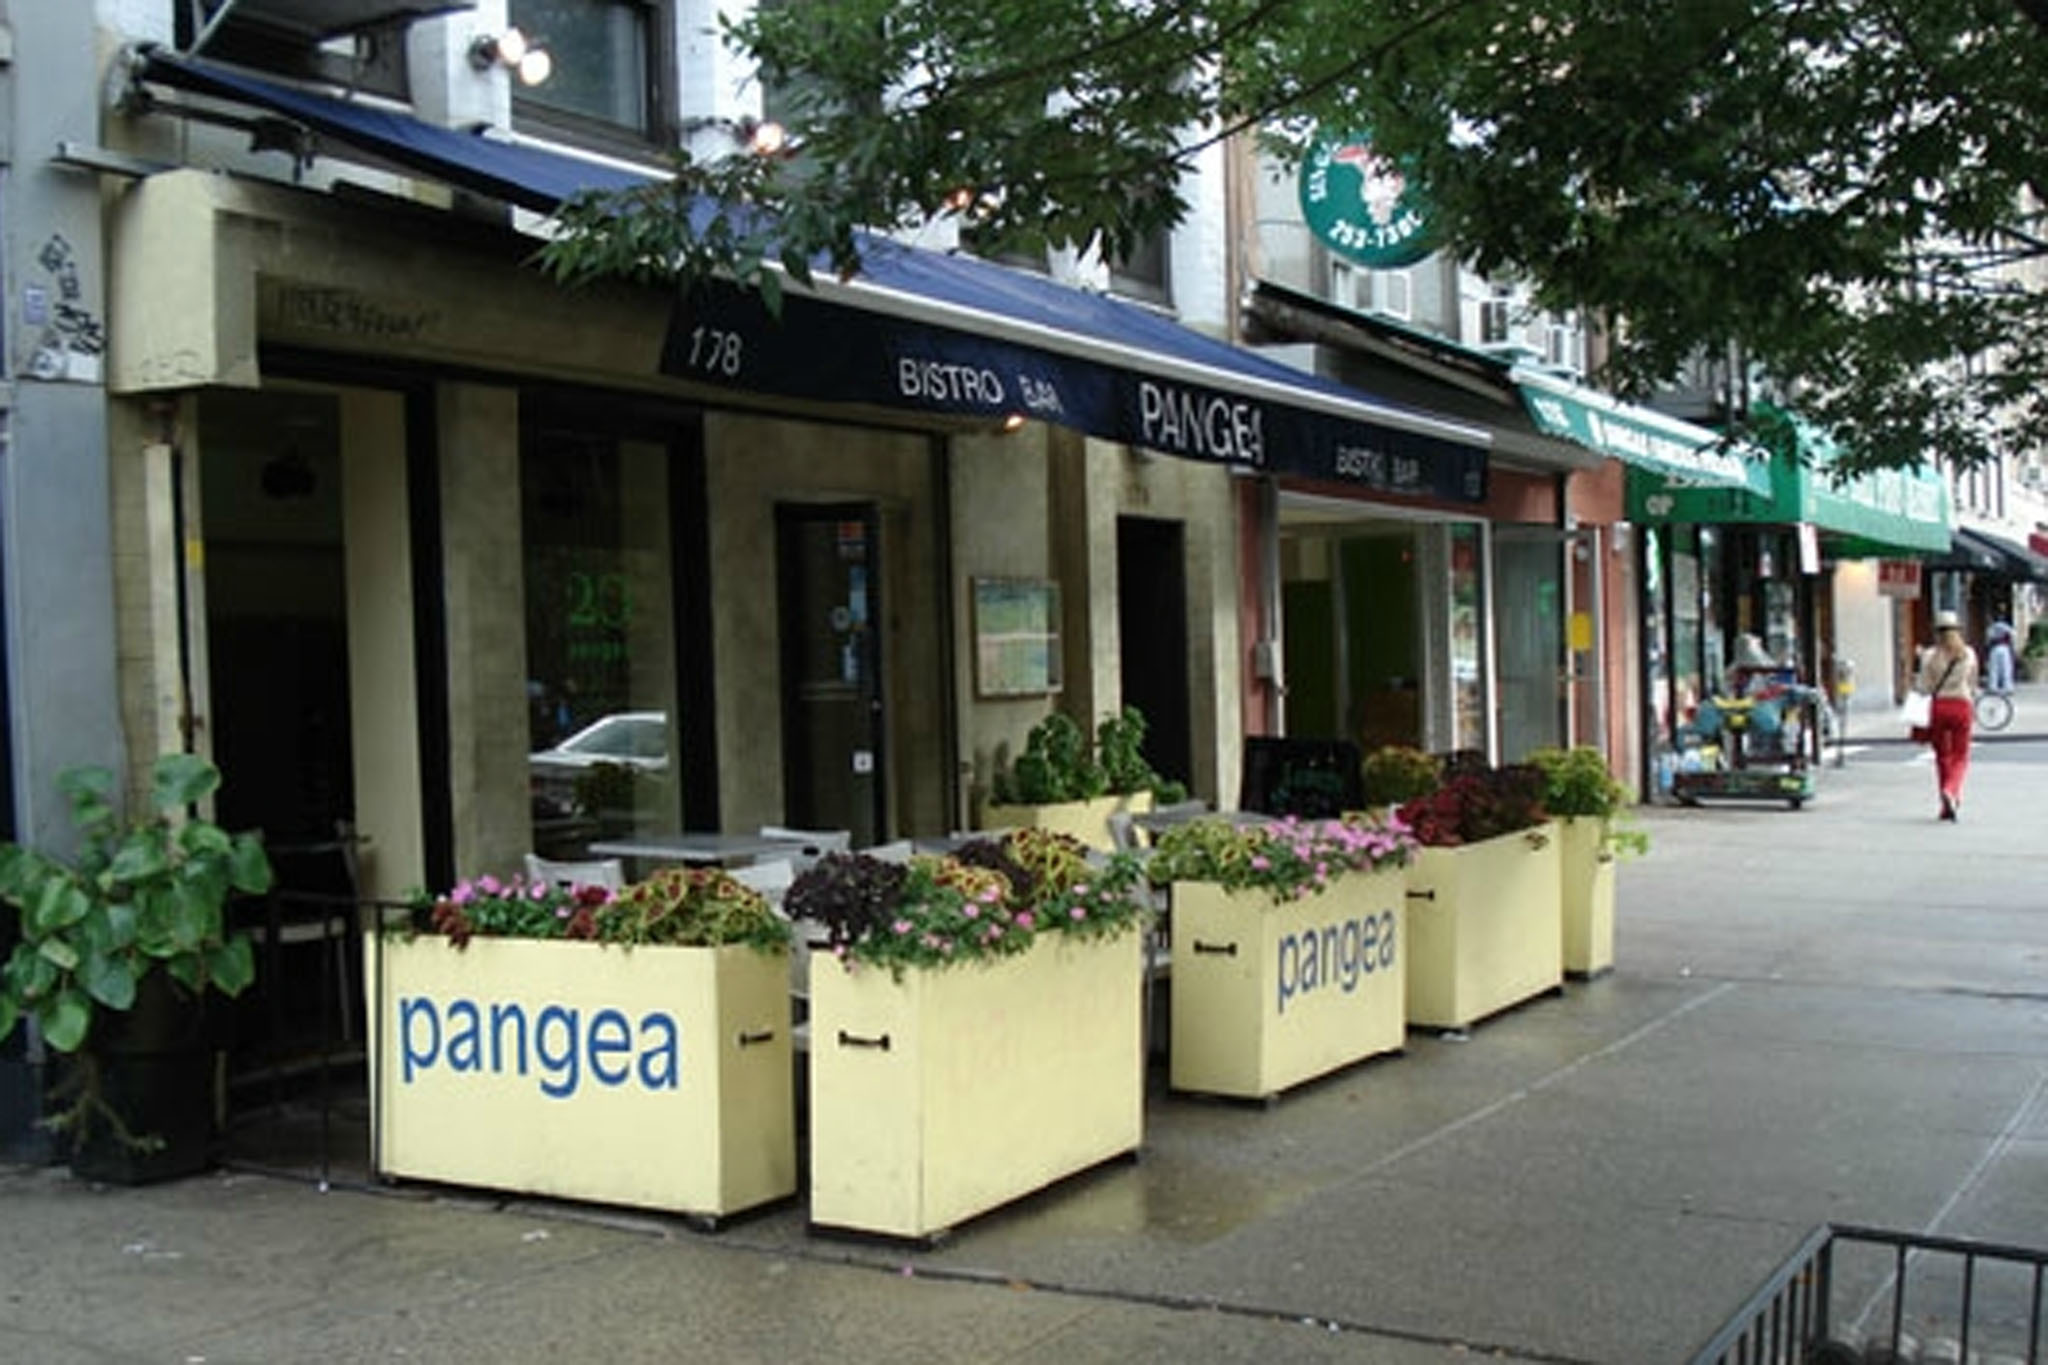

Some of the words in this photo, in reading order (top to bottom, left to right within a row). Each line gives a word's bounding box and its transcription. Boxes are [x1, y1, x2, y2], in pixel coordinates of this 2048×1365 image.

[688, 327, 743, 375] 178
[899, 358, 1004, 403] BISTRO
[1139, 382, 1265, 464] PANGEA
[1278, 909, 1395, 1015] pangea
[400, 996, 680, 1098] pangea
